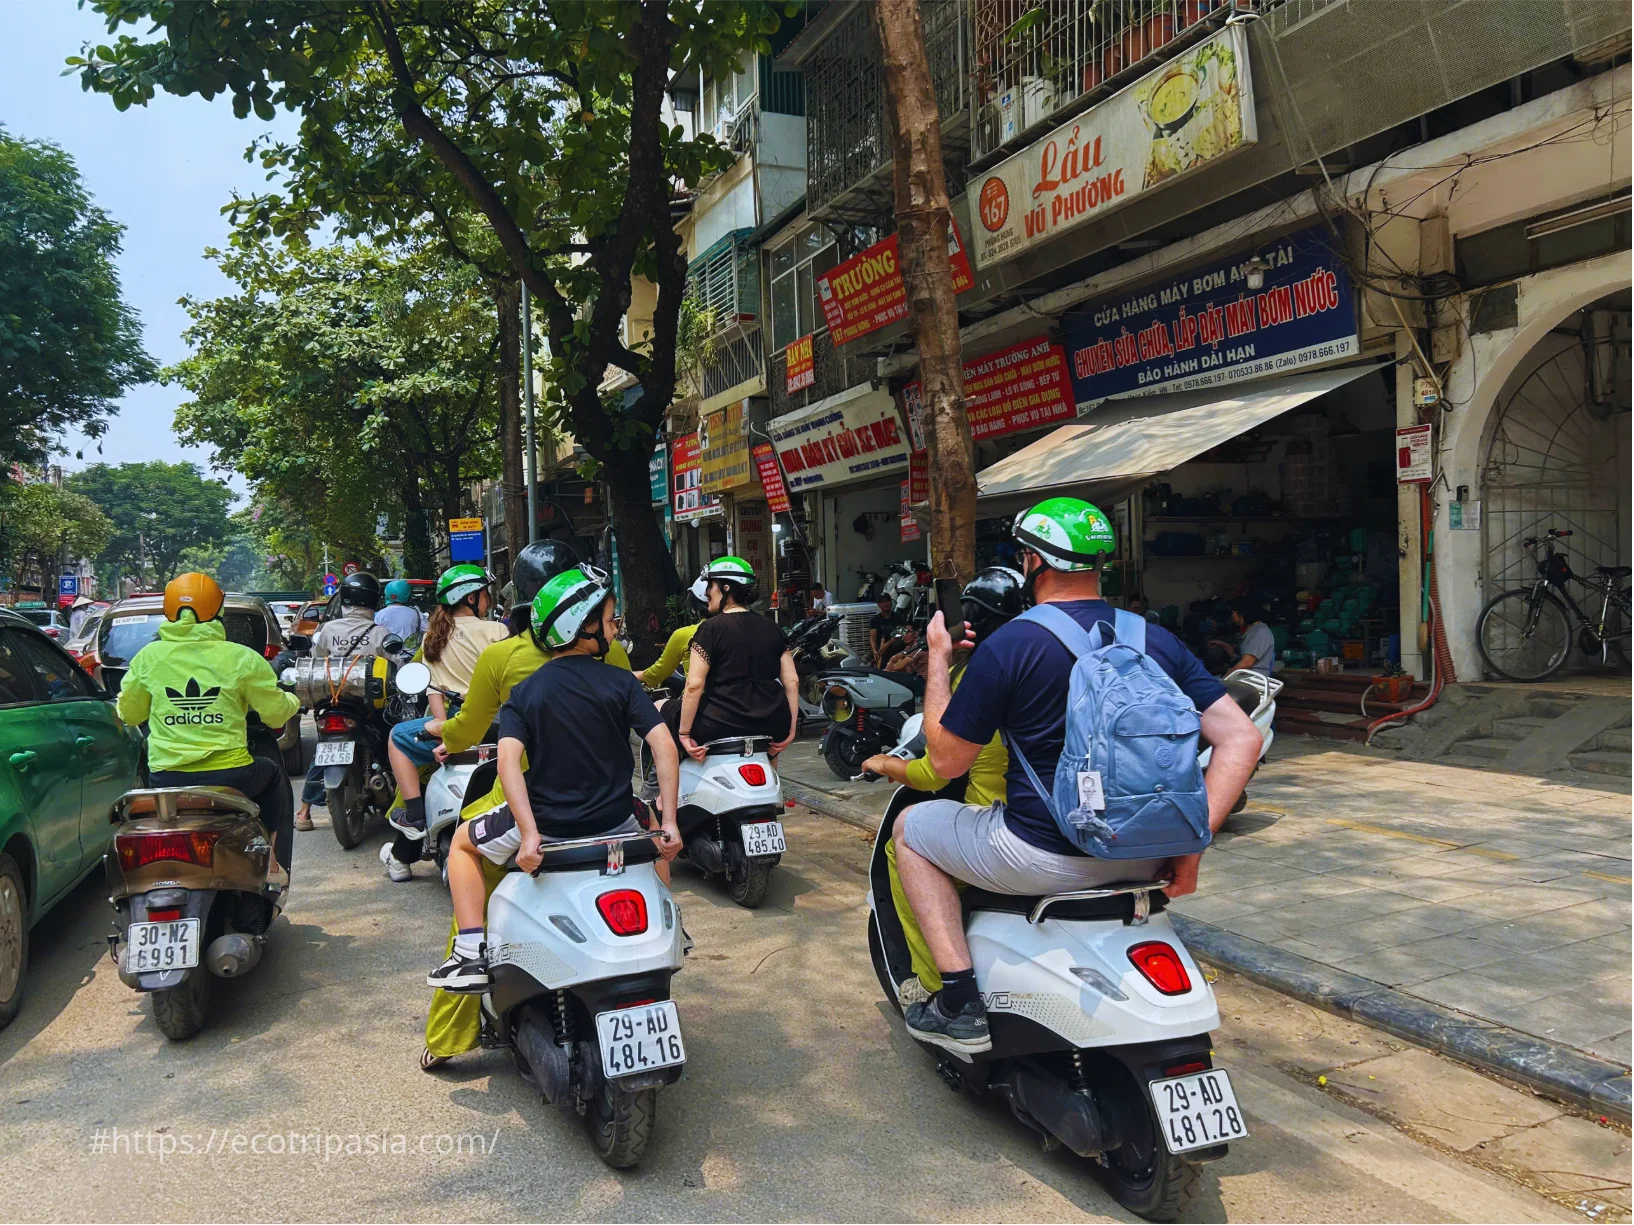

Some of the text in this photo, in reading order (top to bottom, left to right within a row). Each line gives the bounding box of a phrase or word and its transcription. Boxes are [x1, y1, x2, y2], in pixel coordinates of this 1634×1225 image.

[1032, 125, 1107, 199] Lẩu
[984, 194, 1005, 226] 167
[1024, 168, 1125, 239] VŨ PHƯƠNG
[832, 250, 896, 300] TRƯỜNG
[1094, 307, 1119, 327] CỬA
[1122, 293, 1157, 318] HÀNG
[1160, 280, 1188, 304] MÁY
[1193, 272, 1226, 295] BƠM
[1265, 246, 1294, 271] TÀI
[1074, 337, 1115, 380] CHUYÊN
[1115, 325, 1139, 369] SỬA
[1172, 305, 1198, 354] LẮP
[1197, 301, 1225, 351] ĐẶT
[1225, 291, 1257, 338] MÁY
[1259, 284, 1294, 329] BƠM
[1293, 266, 1339, 319] NƯỚC
[963, 342, 1050, 382] IỆN MÁY TRƯỜNG ANH
[1137, 343, 1256, 384] BẢO HÀNH DÀI HẠN
[1275, 354, 1297, 370] (Zalo)
[1298, 341, 1350, 363] 0978.666.197
[988, 390, 1002, 402] LẠNH
[1038, 372, 1050, 386] BẾP
[976, 407, 988, 422] CÁC
[988, 404, 1002, 418] LOẠI
[1012, 396, 1028, 412] ĐIỆN
[1028, 394, 1040, 405] GIA
[1040, 388, 1061, 403] DỤNG
[976, 419, 988, 434] BẢO
[1012, 412, 1030, 426] PHỤC
[1030, 410, 1040, 422] VỤ
[1040, 406, 1052, 420] TẠI
[1052, 400, 1068, 415] NHÀ
[854, 424, 878, 455] XE
[164, 711, 224, 726] adidas
[318, 753, 351, 764] 024.56
[322, 742, 348, 753] 29-AE
[748, 824, 778, 840] 29-AD
[748, 838, 785, 854] 485.40
[136, 944, 189, 969] 6991
[978, 992, 1013, 1009] VO
[608, 1006, 669, 1042] 29-AD
[608, 1034, 681, 1075] 484.16
[1164, 1075, 1224, 1114] 29-AD
[1170, 1105, 1242, 1148] 481.28
